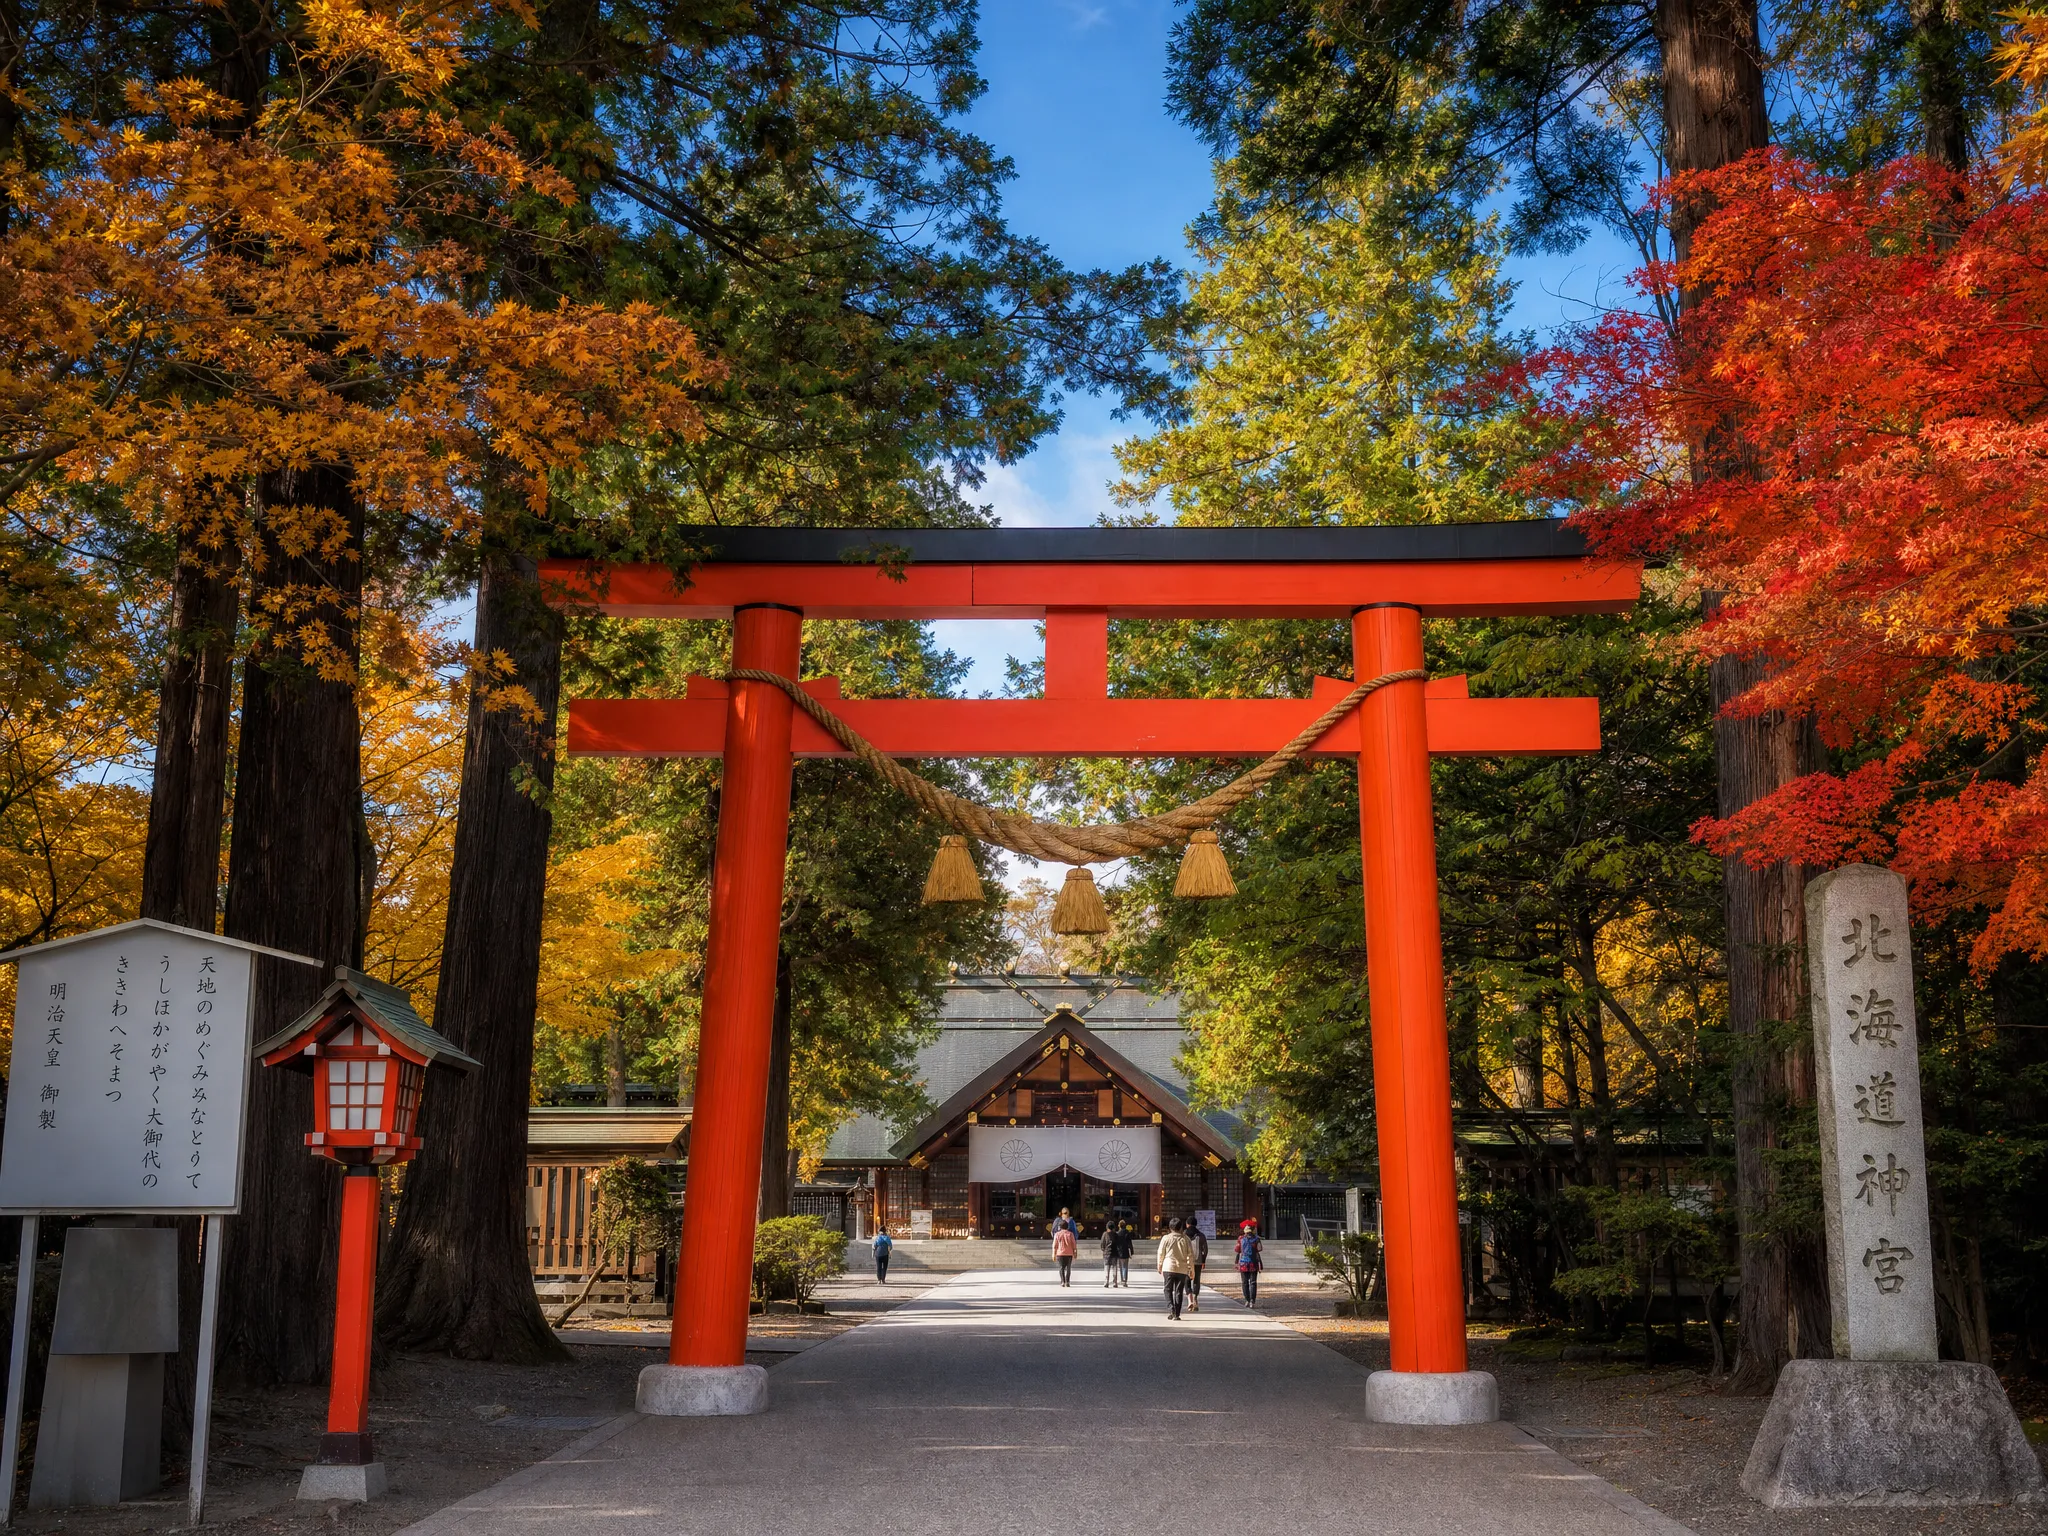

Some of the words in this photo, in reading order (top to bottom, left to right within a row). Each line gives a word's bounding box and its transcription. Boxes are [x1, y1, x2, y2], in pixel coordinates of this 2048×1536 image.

[44, 982, 66, 1068] 明治天皇
[38, 1084, 59, 1130] 御製
[1842, 913, 1914, 1295] 北海道神宮
